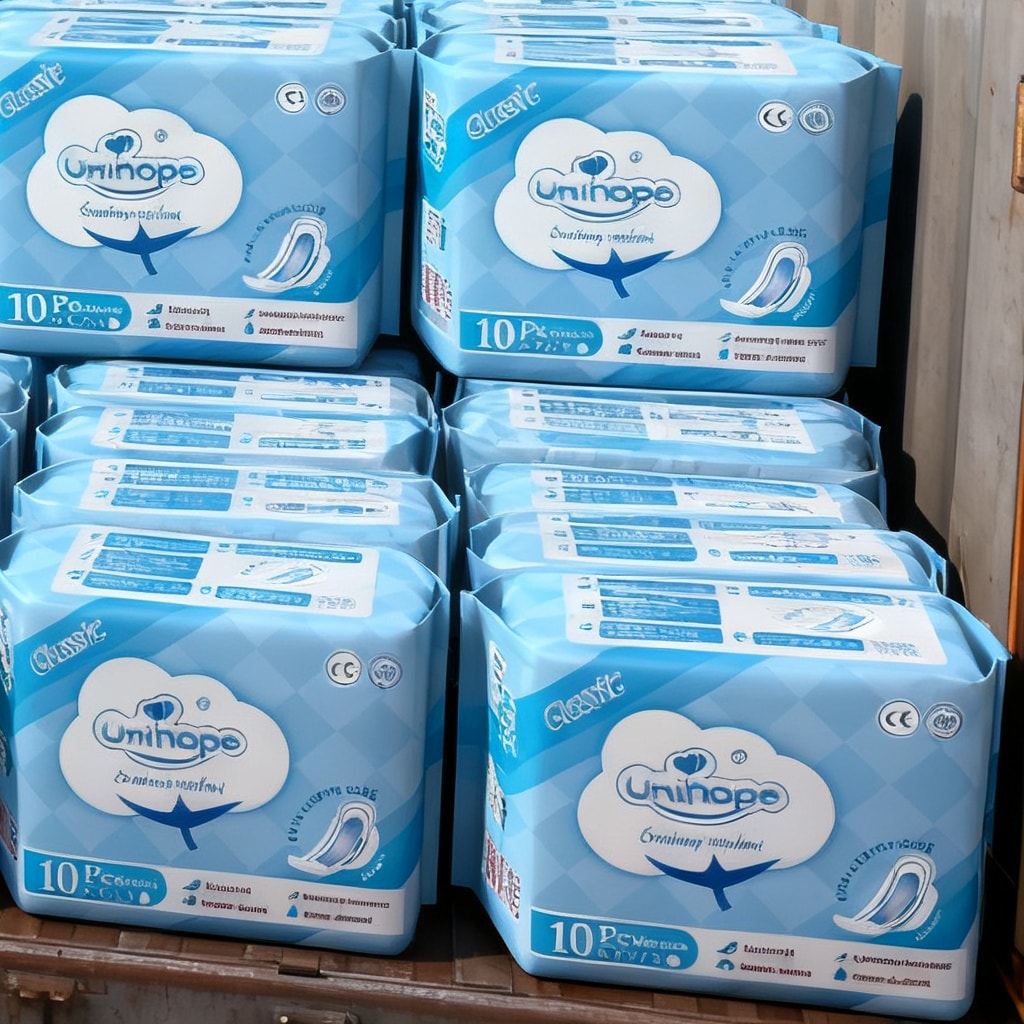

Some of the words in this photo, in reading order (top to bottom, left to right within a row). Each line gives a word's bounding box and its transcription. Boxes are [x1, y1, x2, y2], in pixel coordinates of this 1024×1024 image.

[8, 293, 47, 323] 10
[475, 318, 515, 350] 10
[40, 859, 79, 894] 10
[549, 920, 593, 957] 10
